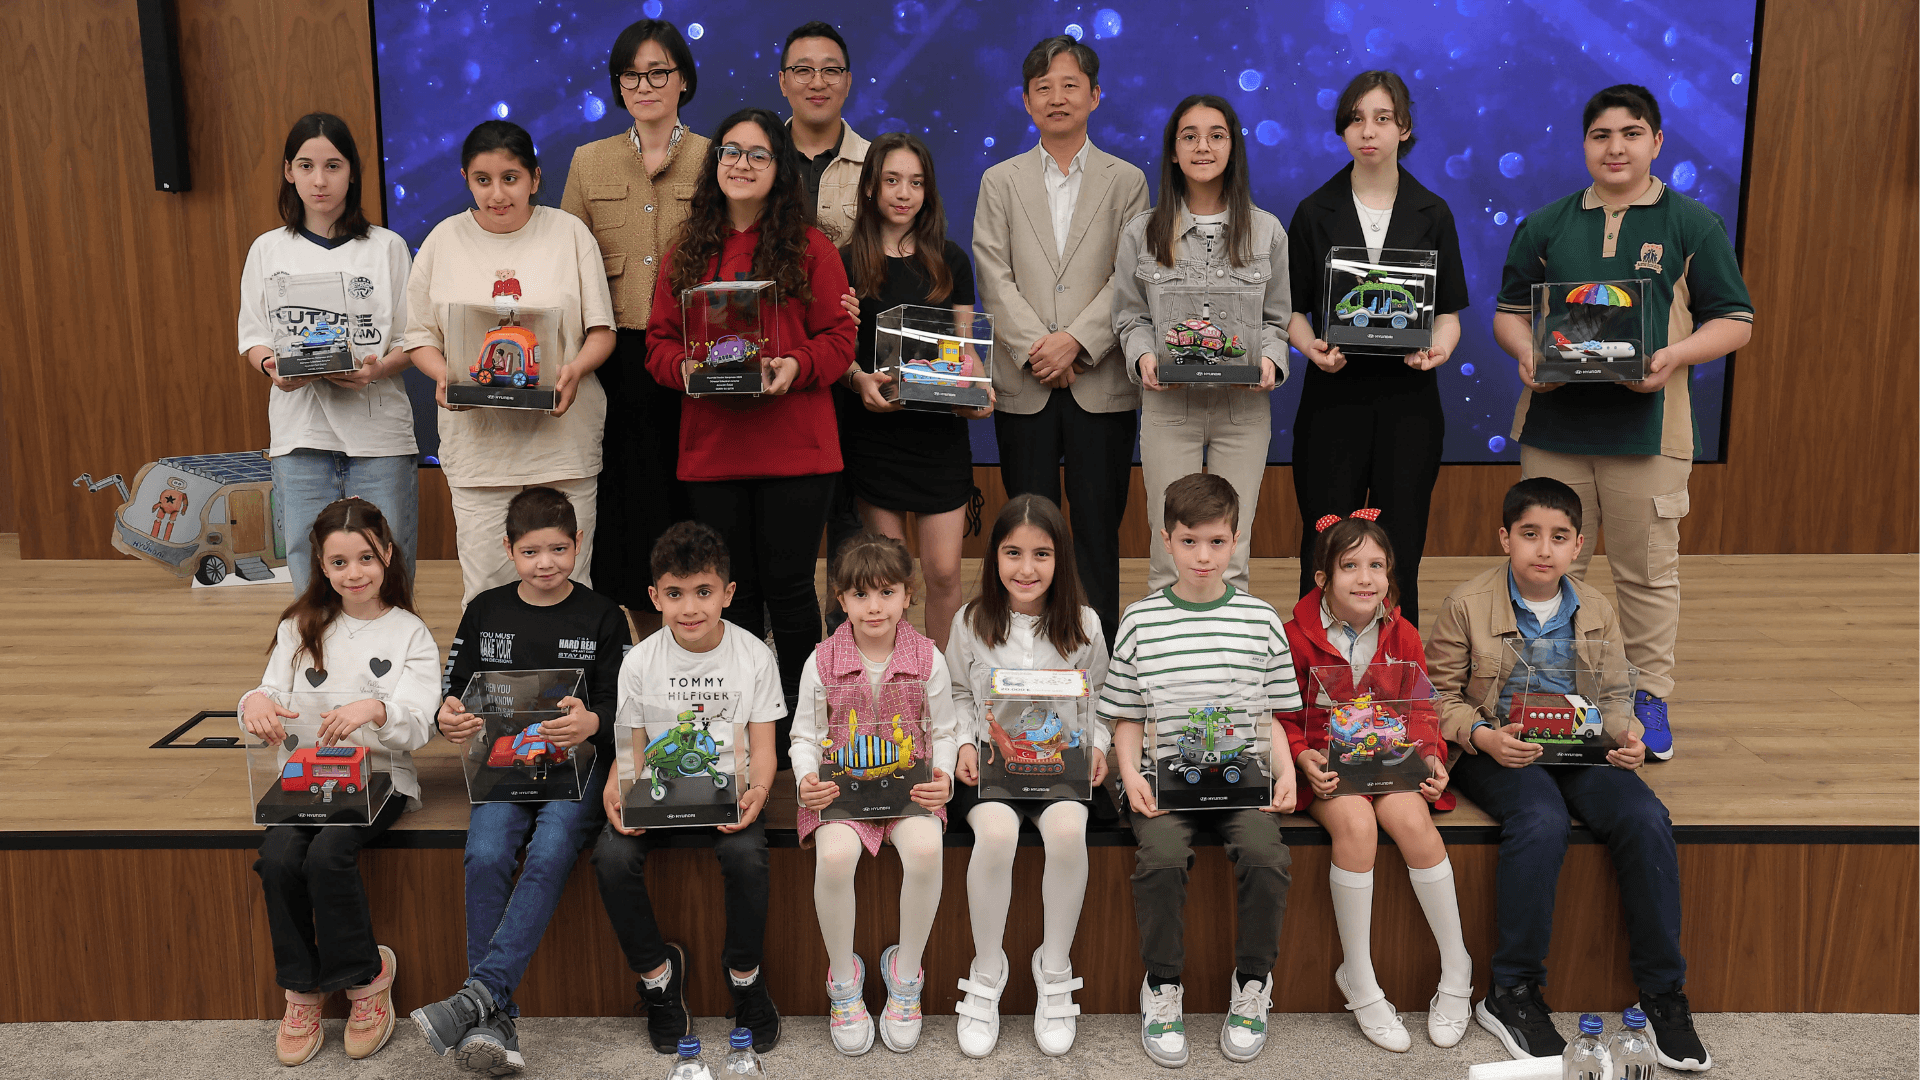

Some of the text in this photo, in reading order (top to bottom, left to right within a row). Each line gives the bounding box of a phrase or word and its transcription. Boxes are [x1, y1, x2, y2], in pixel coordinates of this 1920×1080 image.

[132, 540, 165, 559] HYUNDAI
[495, 632, 516, 640] MUST
[496, 638, 513, 660] YOUR
[558, 639, 580, 650] HARD
[669, 677, 724, 688] TOMMY
[497, 683, 511, 694] YOU
[495, 695, 514, 706] KNOW
[668, 691, 729, 701] HILFIGER
